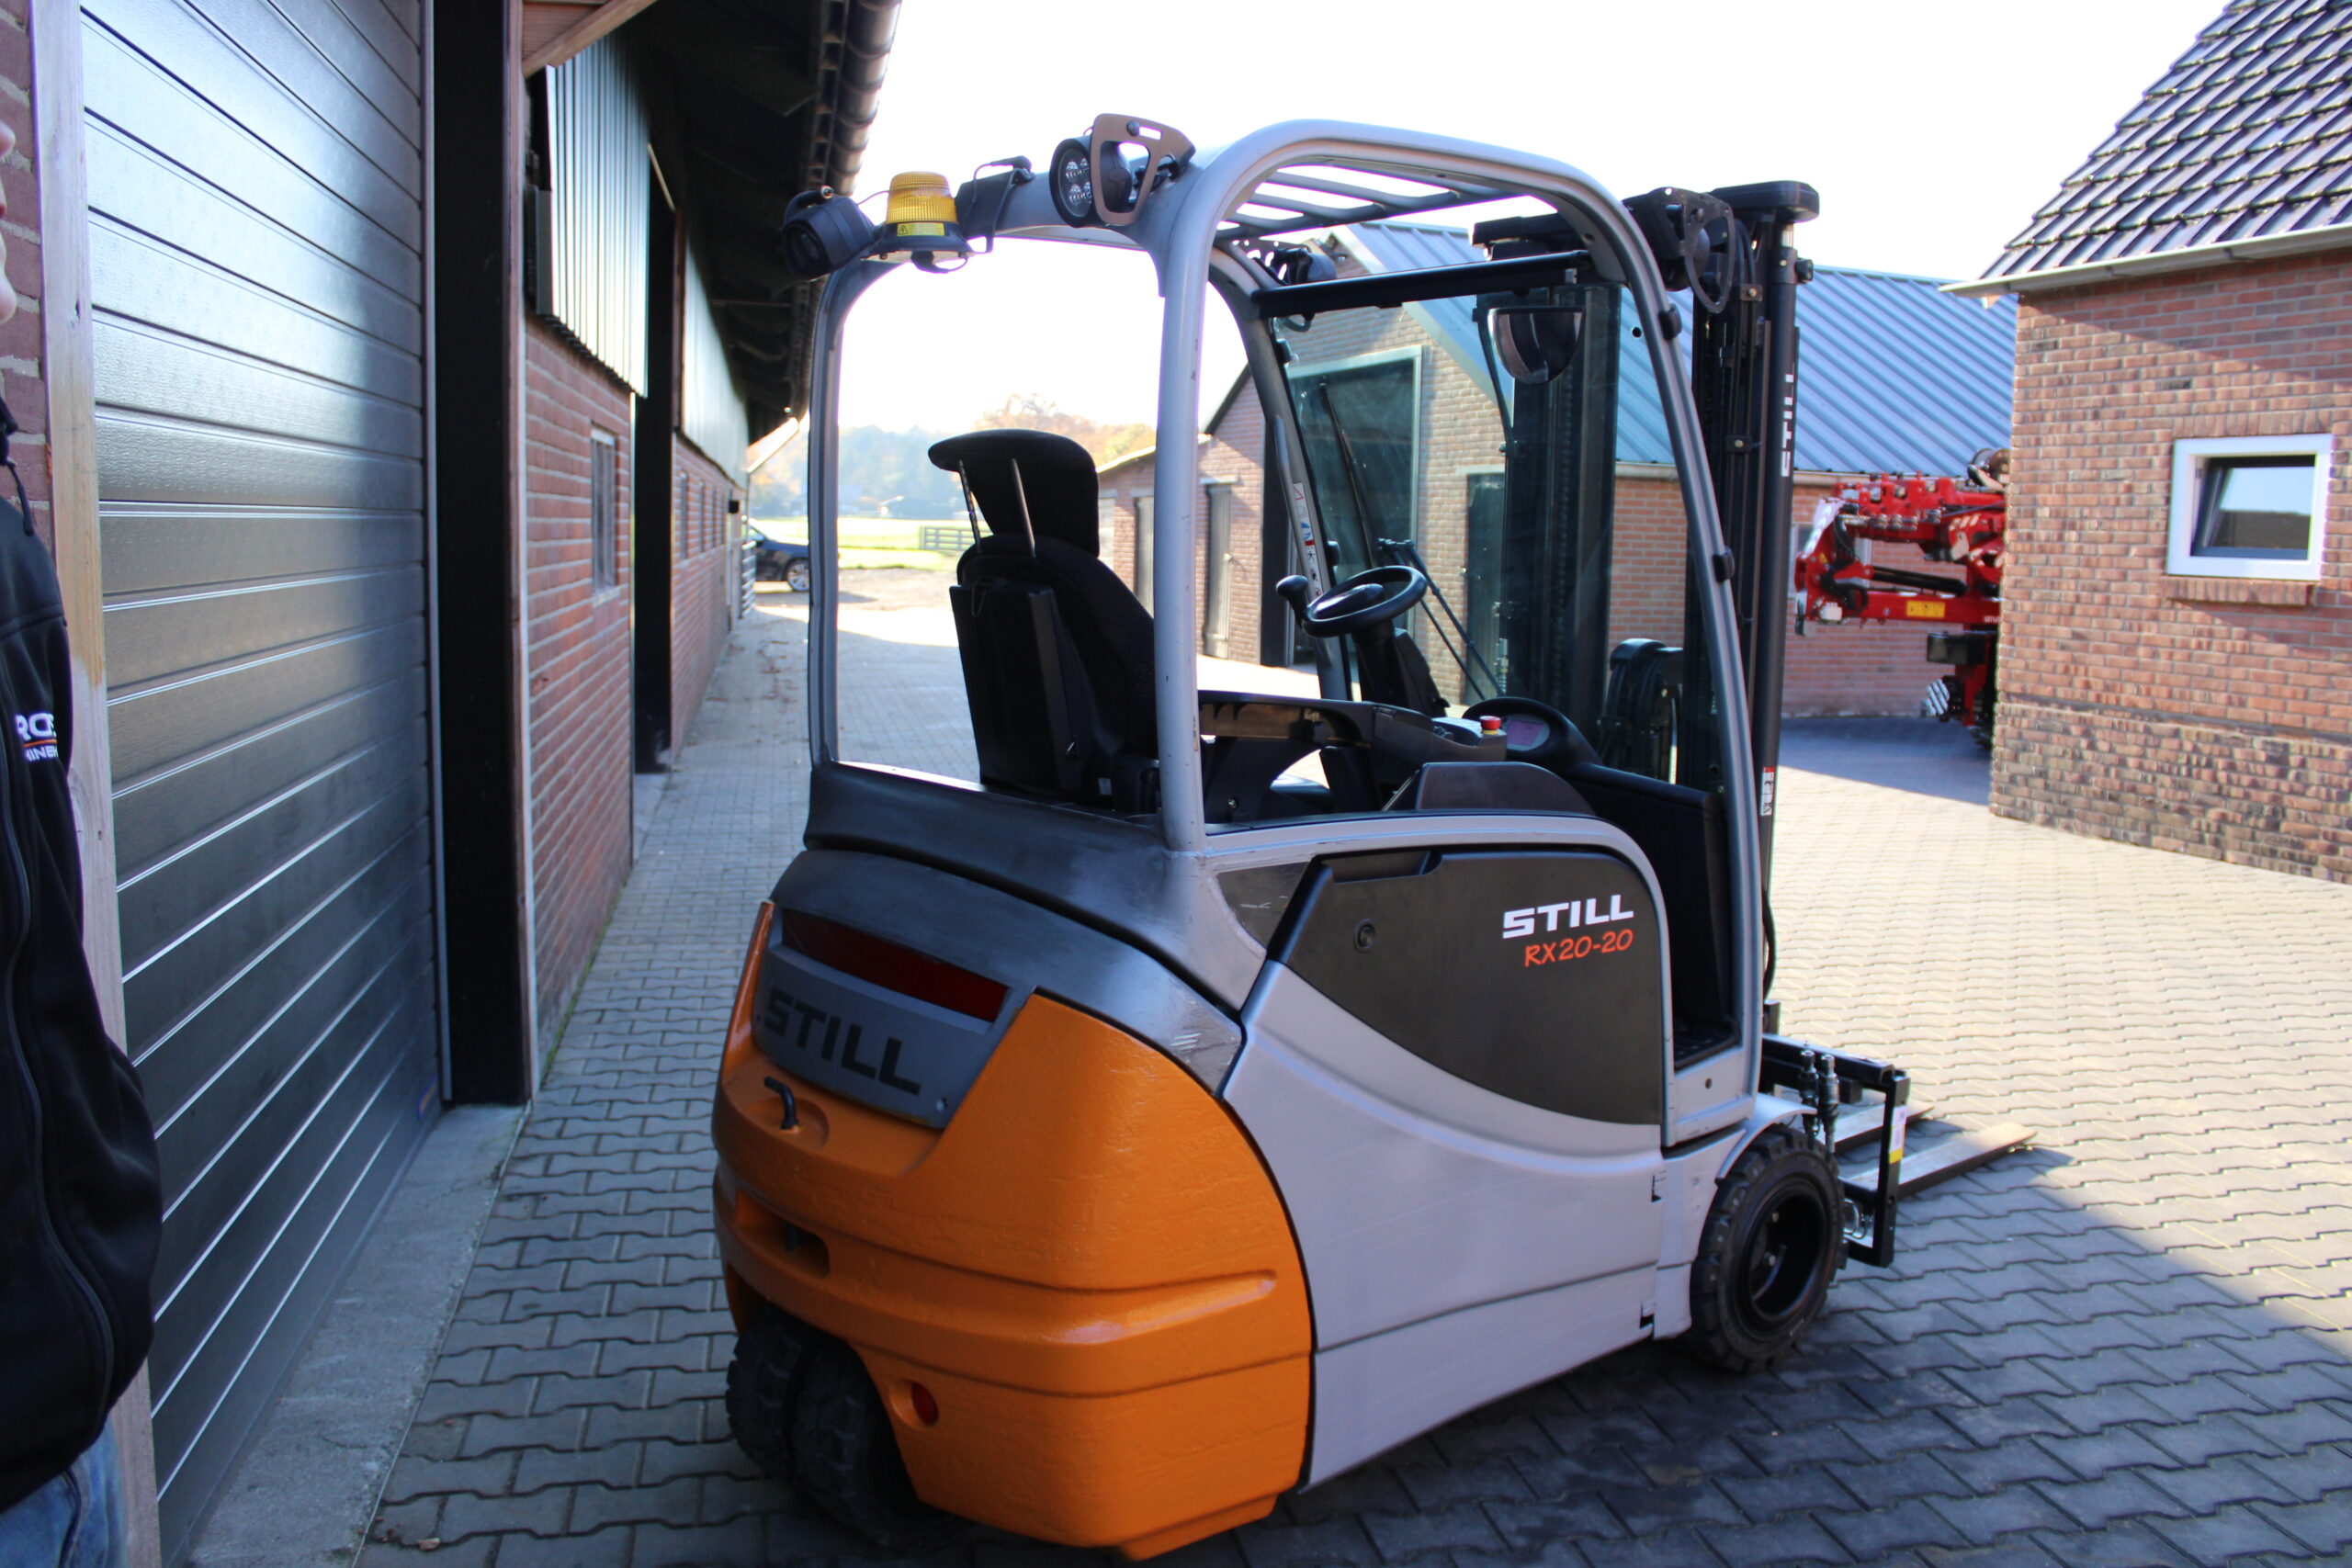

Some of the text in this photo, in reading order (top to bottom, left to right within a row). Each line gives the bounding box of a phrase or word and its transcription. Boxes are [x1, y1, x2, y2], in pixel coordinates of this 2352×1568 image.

[1503, 895, 1634, 938] STILL
[1524, 930, 1634, 967] RX20-20
[766, 987, 921, 1095] STILL
